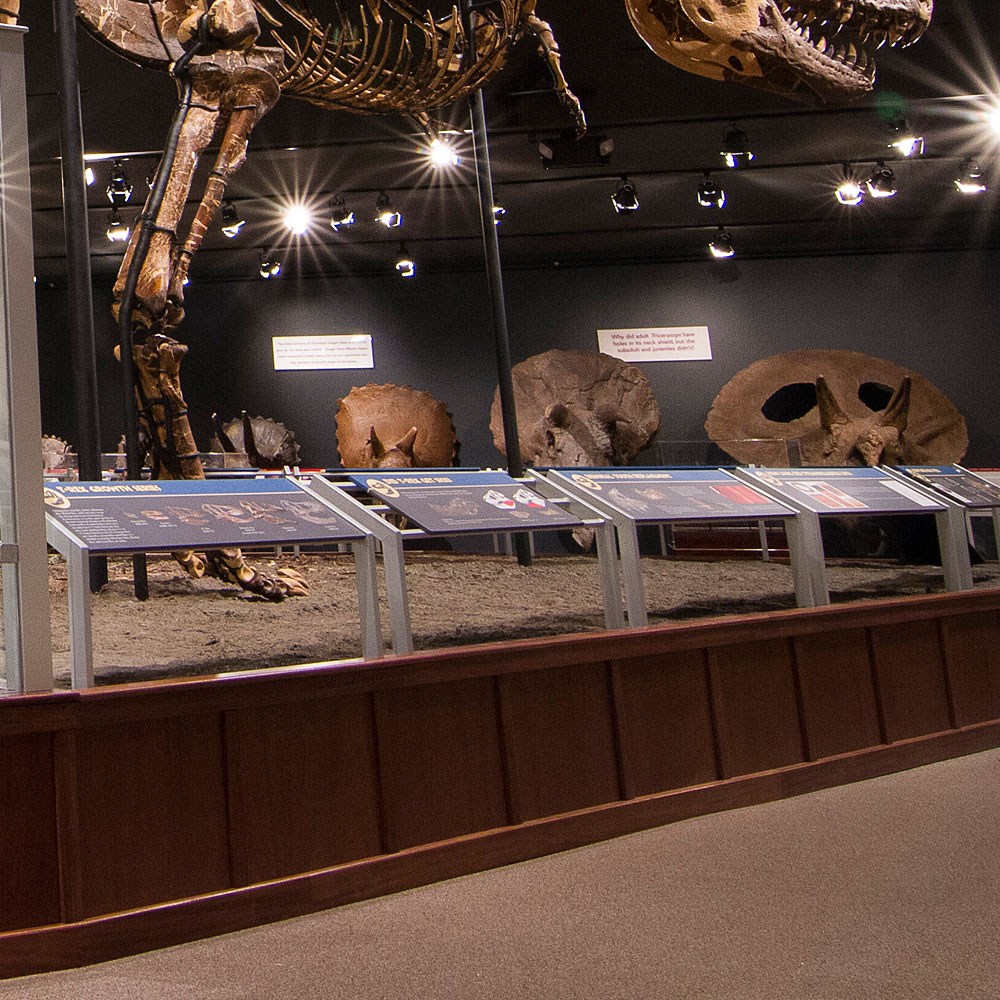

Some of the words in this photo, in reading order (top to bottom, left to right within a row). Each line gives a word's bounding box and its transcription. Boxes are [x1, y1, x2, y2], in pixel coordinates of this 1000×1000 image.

[55, 485, 89, 493] T-REX
[88, 484, 133, 493] GROWTH
[132, 484, 162, 492] SERIES
